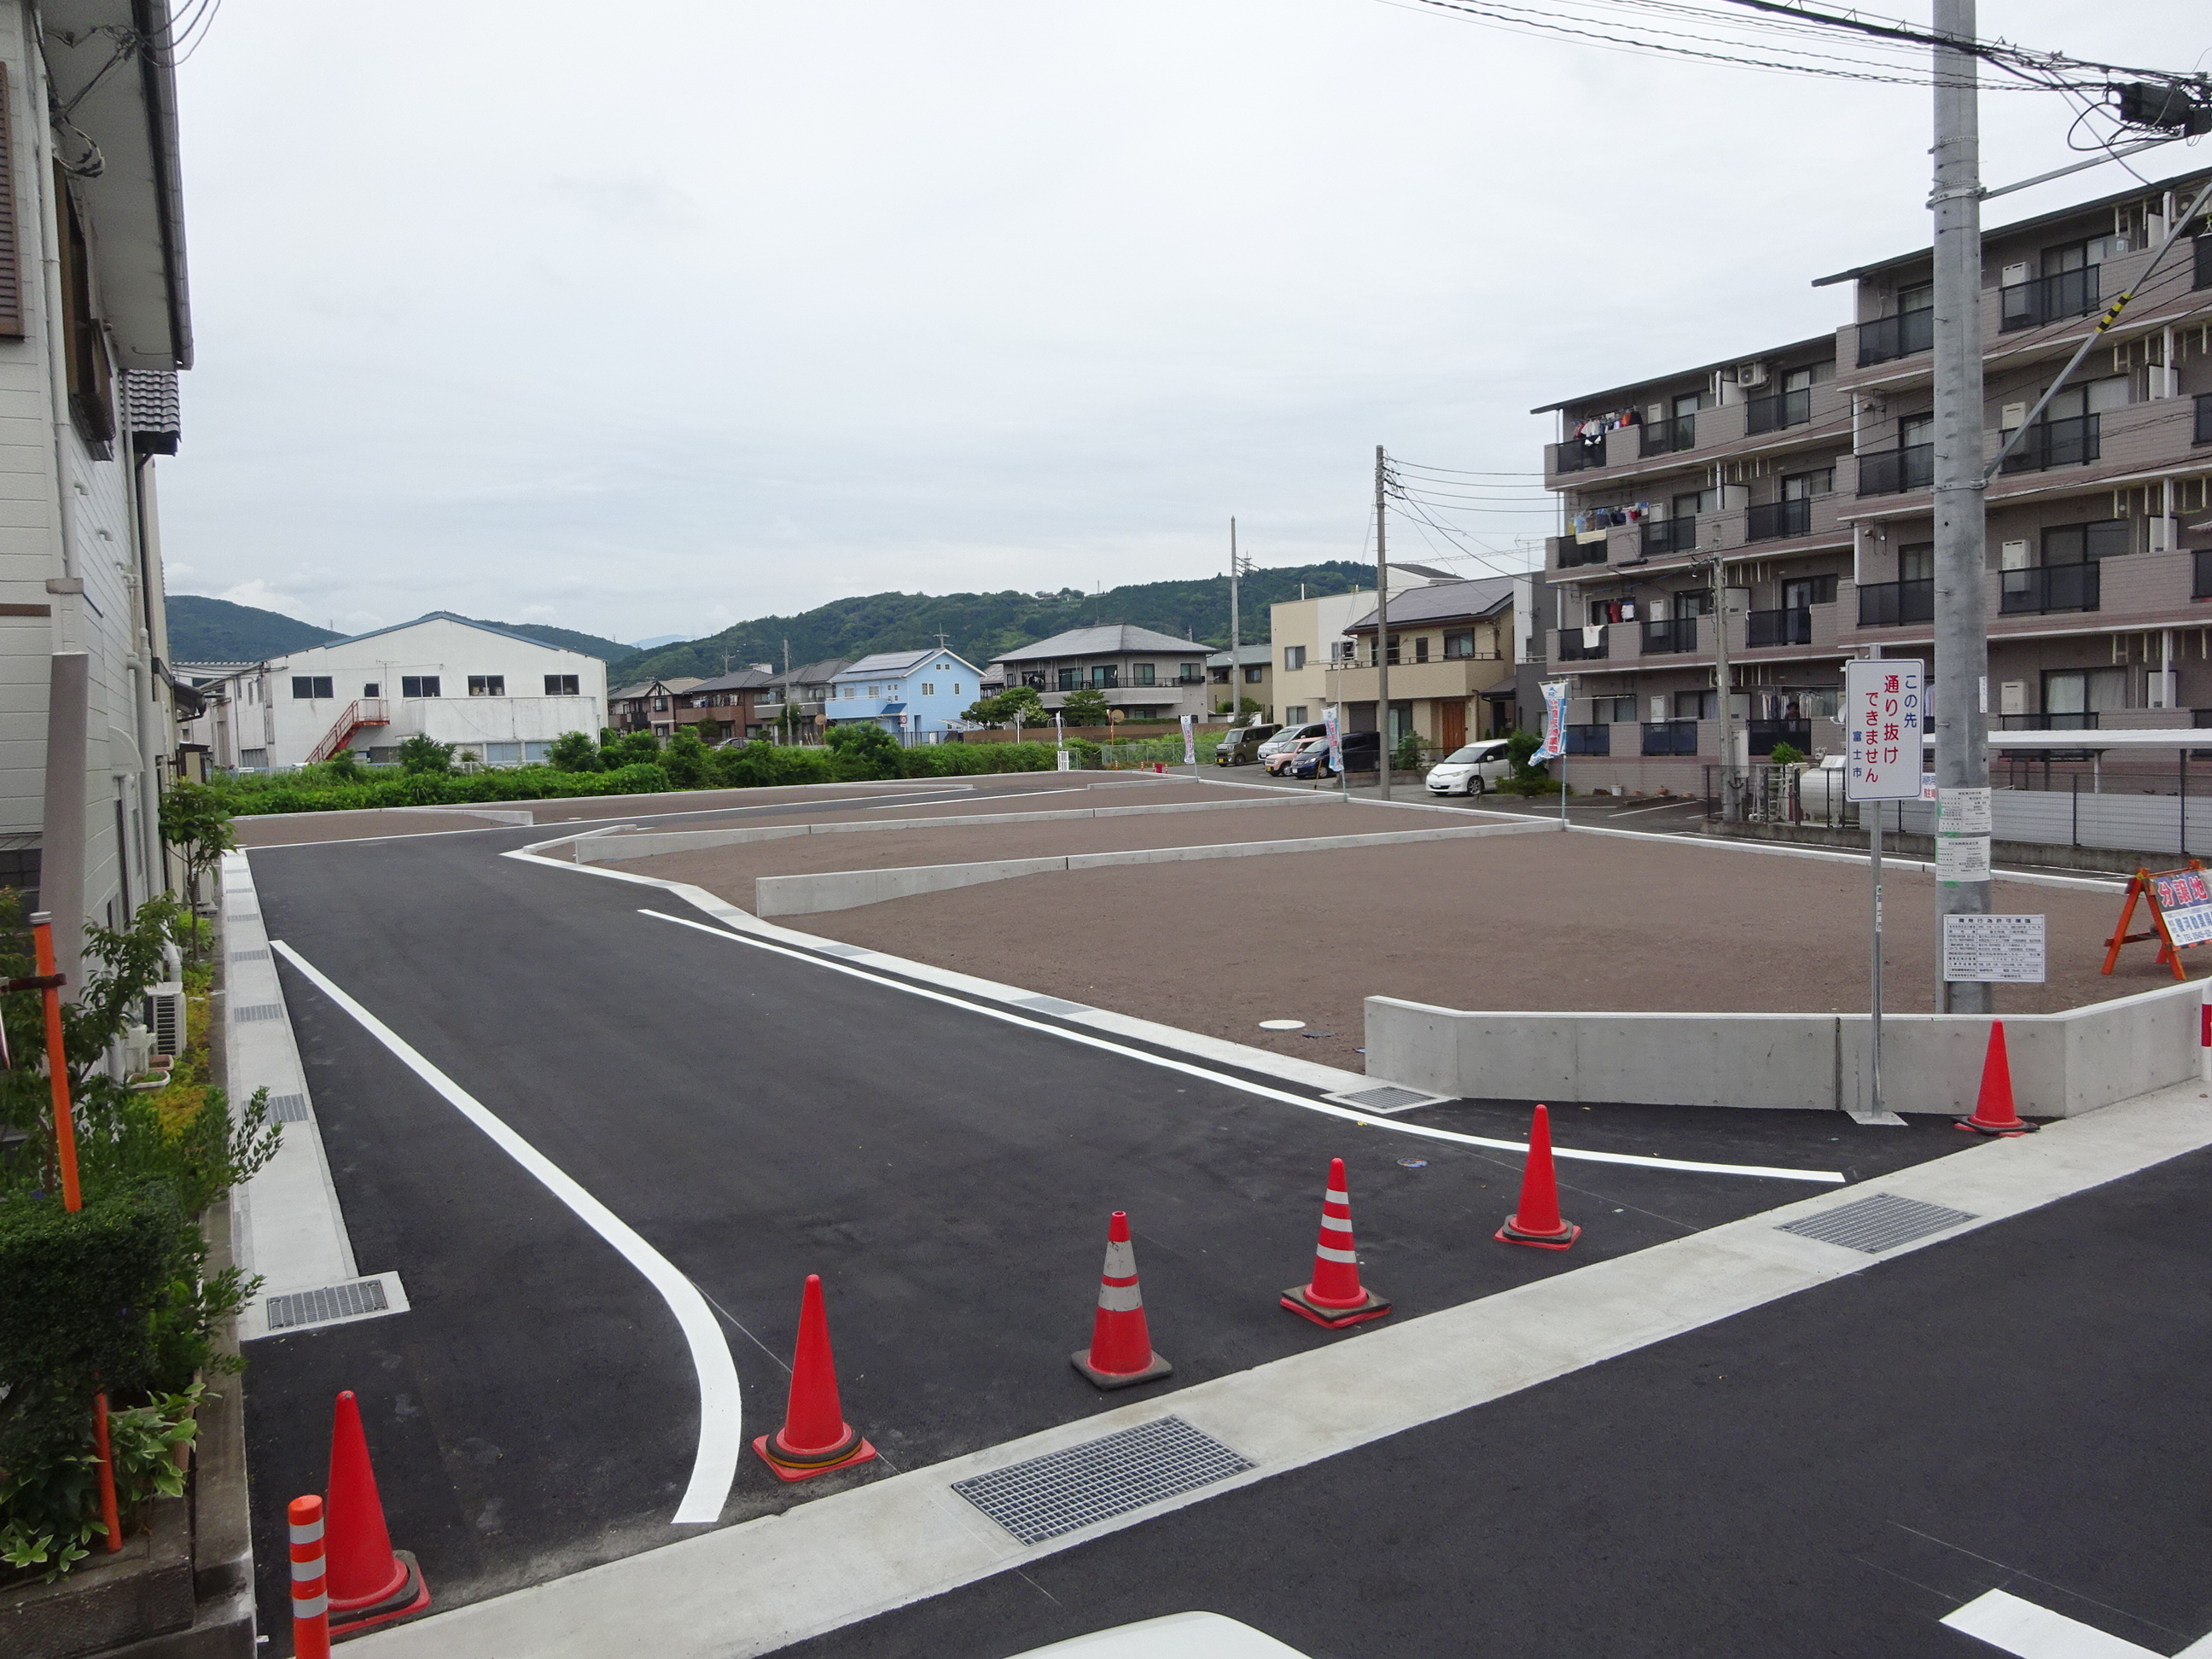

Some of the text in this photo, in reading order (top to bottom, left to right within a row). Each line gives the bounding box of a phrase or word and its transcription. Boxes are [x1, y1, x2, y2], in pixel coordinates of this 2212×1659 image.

[1883, 674, 1900, 765] 通り抜け
[1903, 674, 1918, 729] この先
[1852, 731, 1862, 778] 富士市
[1865, 691, 1879, 783] できません
[2157, 876, 2209, 908] 分譲地
